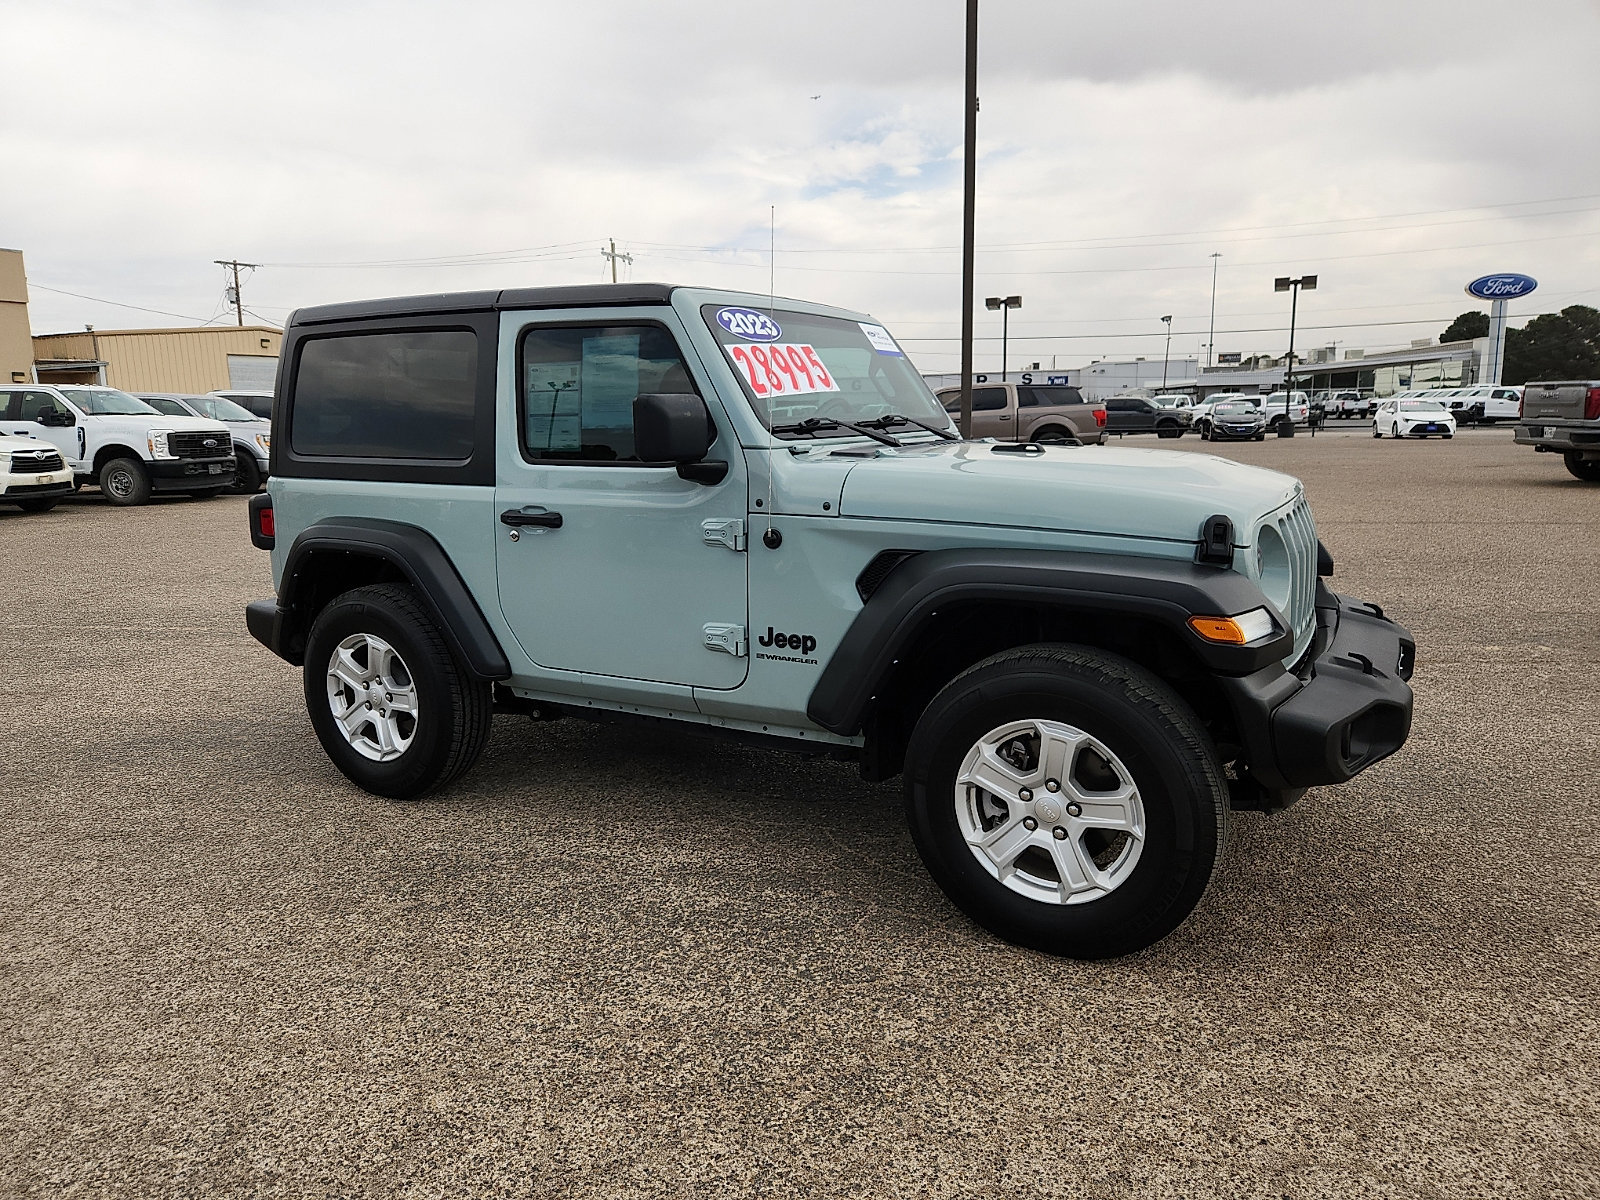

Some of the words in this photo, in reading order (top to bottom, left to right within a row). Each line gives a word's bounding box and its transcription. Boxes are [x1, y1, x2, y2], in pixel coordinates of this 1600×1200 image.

[1483, 277, 1525, 295] Ford
[721, 311, 779, 337] 2023
[732, 345, 832, 394] 28995
[758, 626, 817, 655] Jeep
[765, 653, 818, 665] WRANGLER
